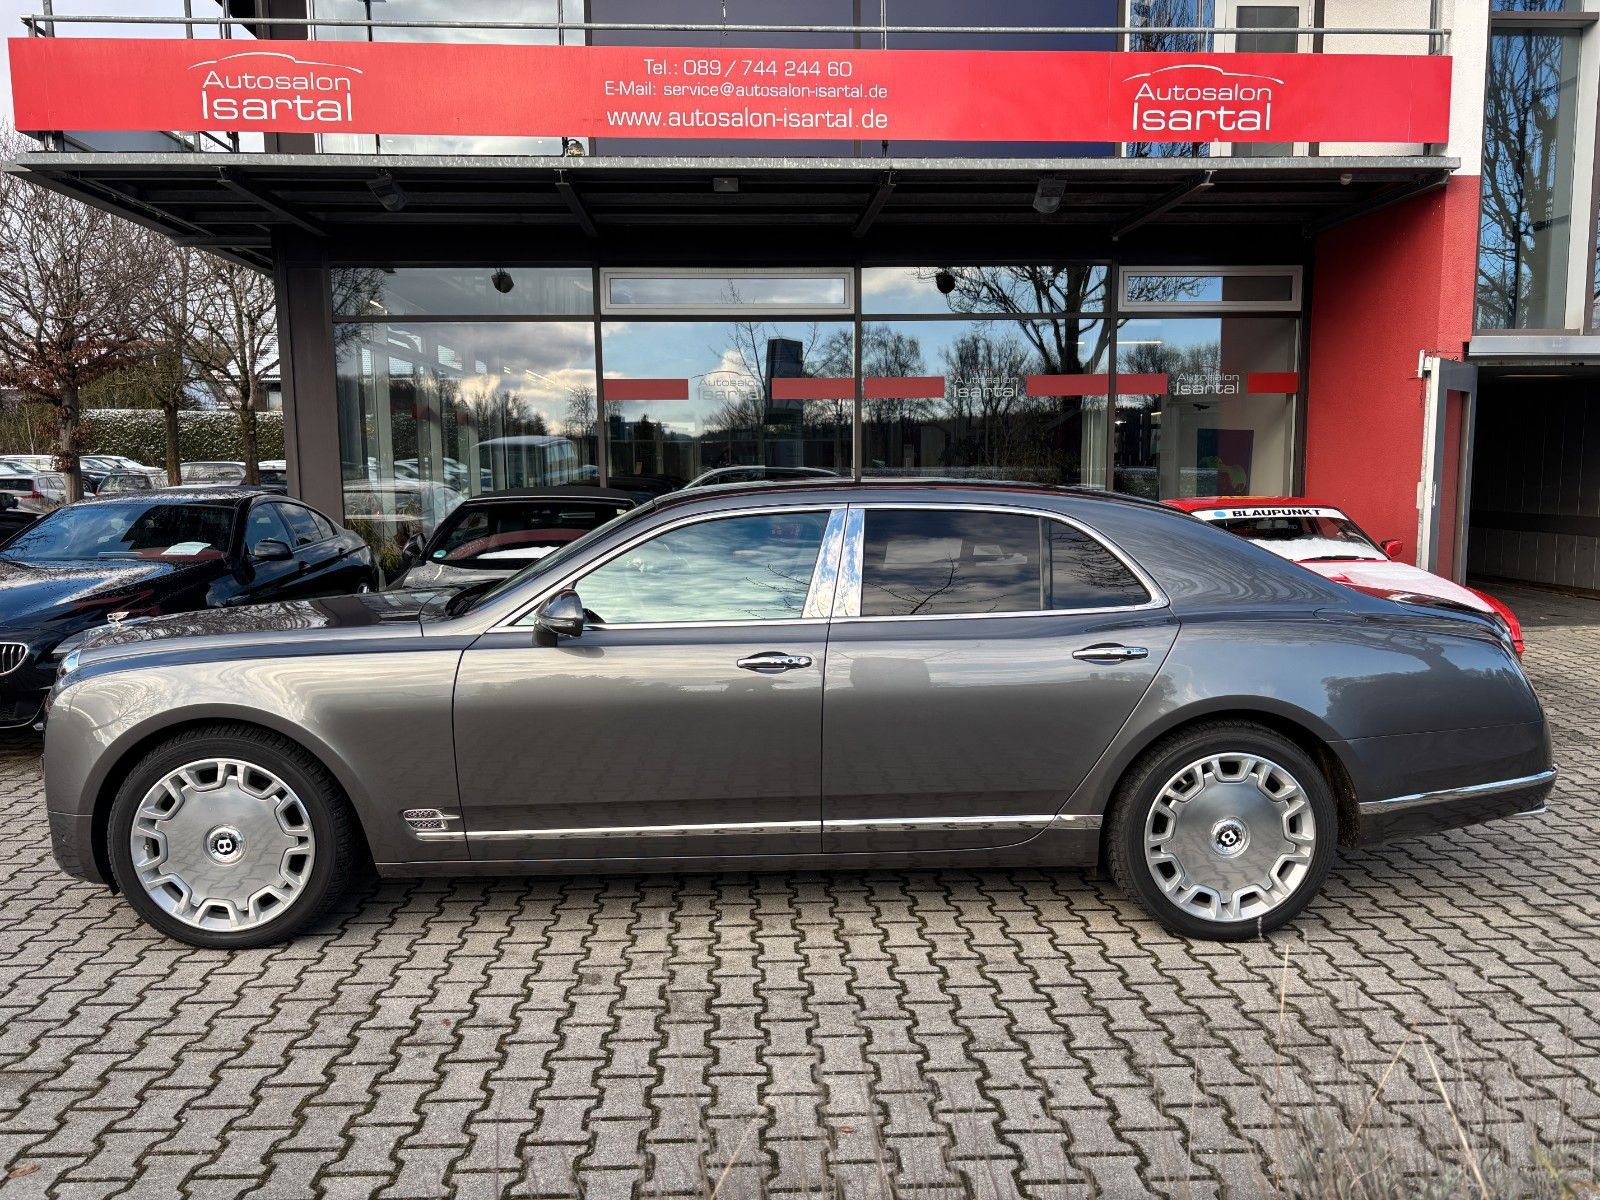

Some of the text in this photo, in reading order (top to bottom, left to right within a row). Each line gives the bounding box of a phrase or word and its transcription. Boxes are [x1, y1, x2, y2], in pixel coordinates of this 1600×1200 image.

[643, 58, 678, 75] Tel.:
[683, 59, 721, 76] 089
[741, 60, 778, 77] 744
[784, 60, 821, 77] 244
[827, 61, 852, 77] 60
[202, 70, 351, 91] Autosalon
[604, 80, 888, 99] E-Mail: service@autosalon-isartal.de
[1134, 82, 1272, 101] Autosalon
[201, 90, 353, 122] Isartal
[606, 106, 888, 129] www.autosalon-isartal.de
[1132, 102, 1271, 131] Isartal
[953, 384, 1018, 398] Isartal
[1232, 509, 1321, 517] BLAUPUNKT
